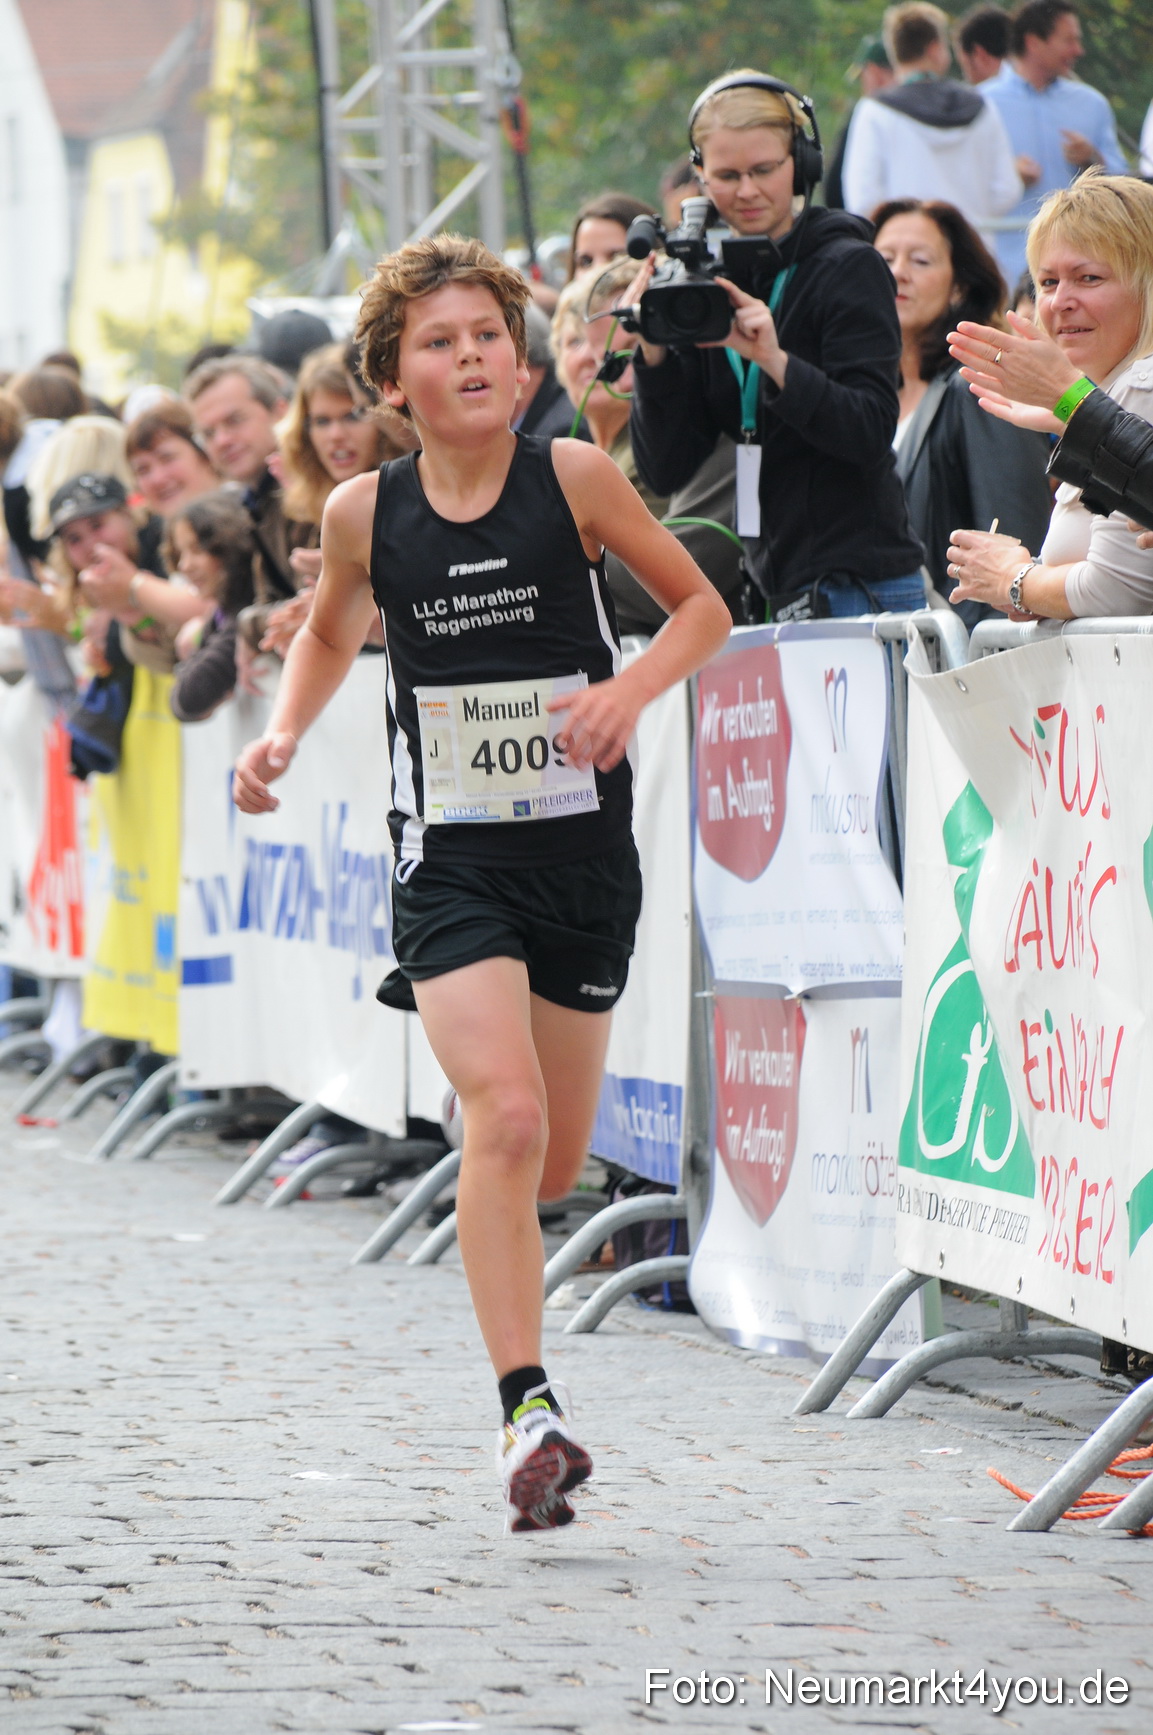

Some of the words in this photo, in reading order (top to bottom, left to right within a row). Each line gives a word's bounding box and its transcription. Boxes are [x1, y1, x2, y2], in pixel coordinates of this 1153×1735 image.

[412, 599, 449, 620] LLC
[452, 585, 540, 613] Marathon
[424, 605, 535, 637] Regensburg
[462, 691, 541, 722] Manuel
[429, 739, 439, 758] J
[532, 788, 594, 809] PFLEIDERER
